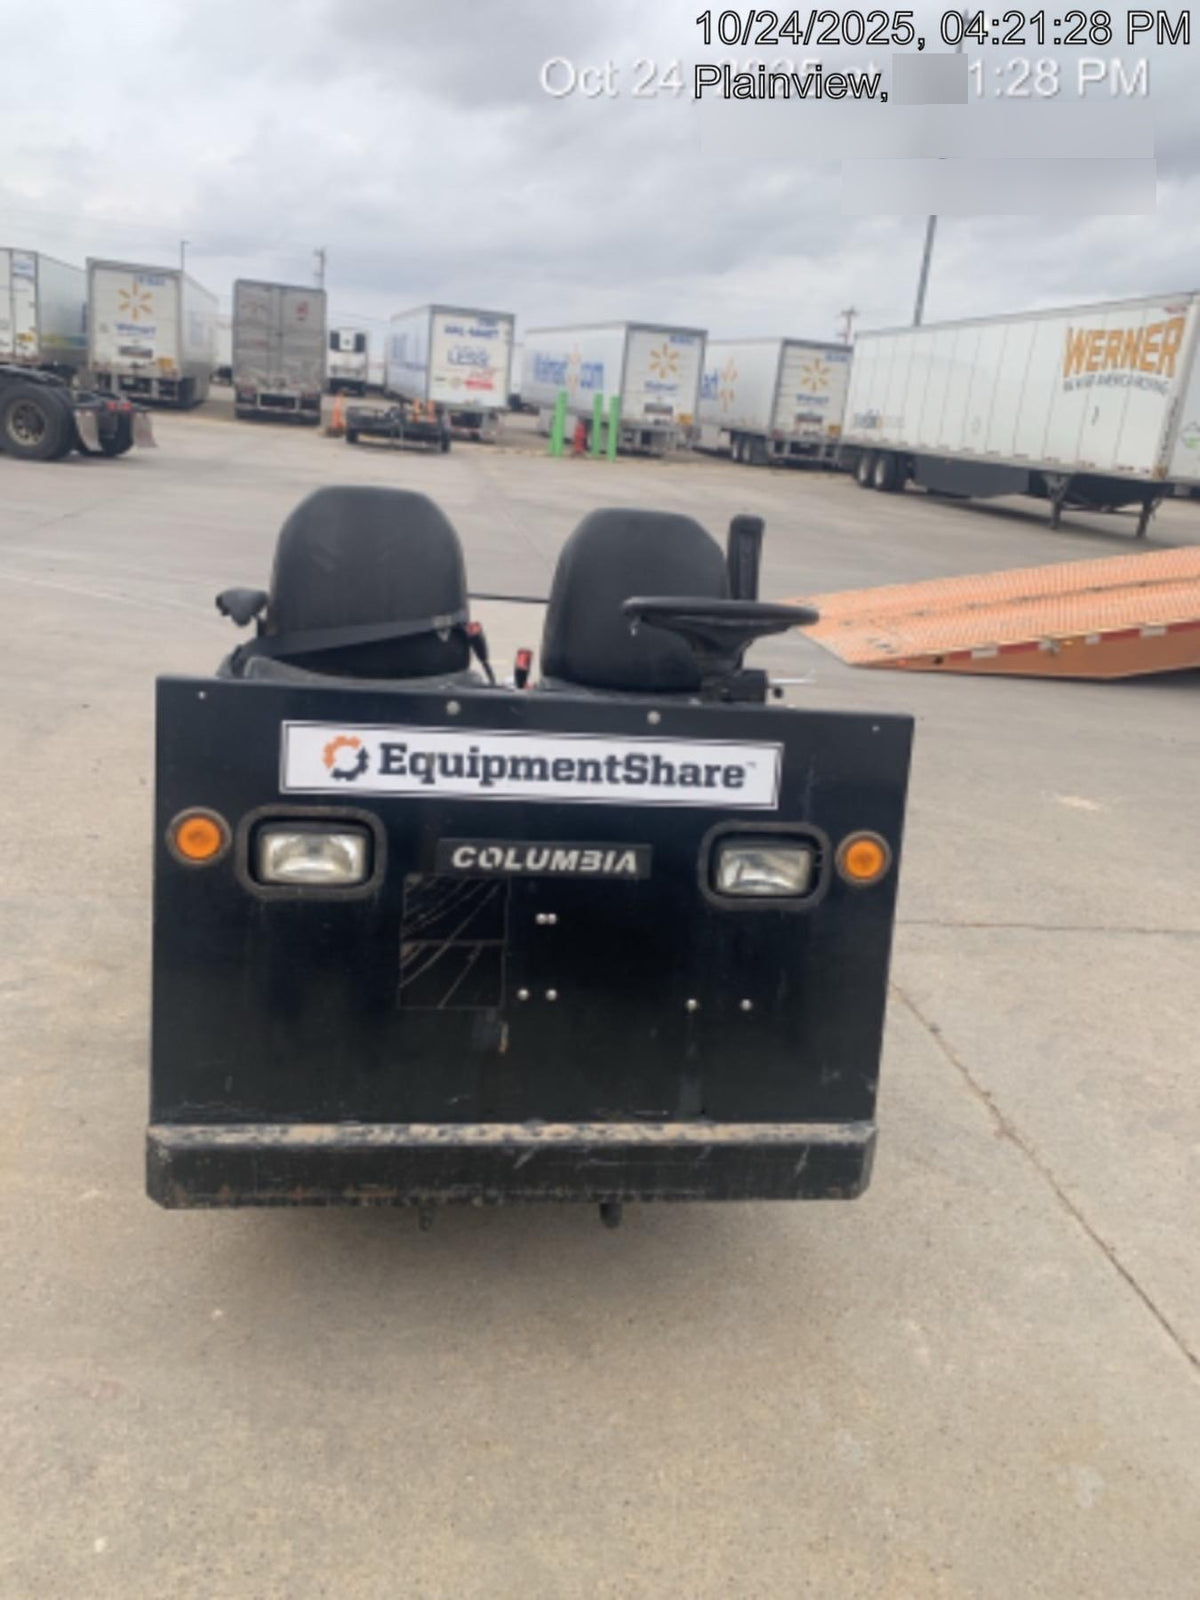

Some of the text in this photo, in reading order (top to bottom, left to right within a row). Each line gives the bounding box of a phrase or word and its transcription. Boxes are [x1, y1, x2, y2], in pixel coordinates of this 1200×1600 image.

[1063, 317, 1187, 378] WERNER
[378, 742, 746, 789] EquipmentShare
[451, 845, 640, 875] COLUMBIA
